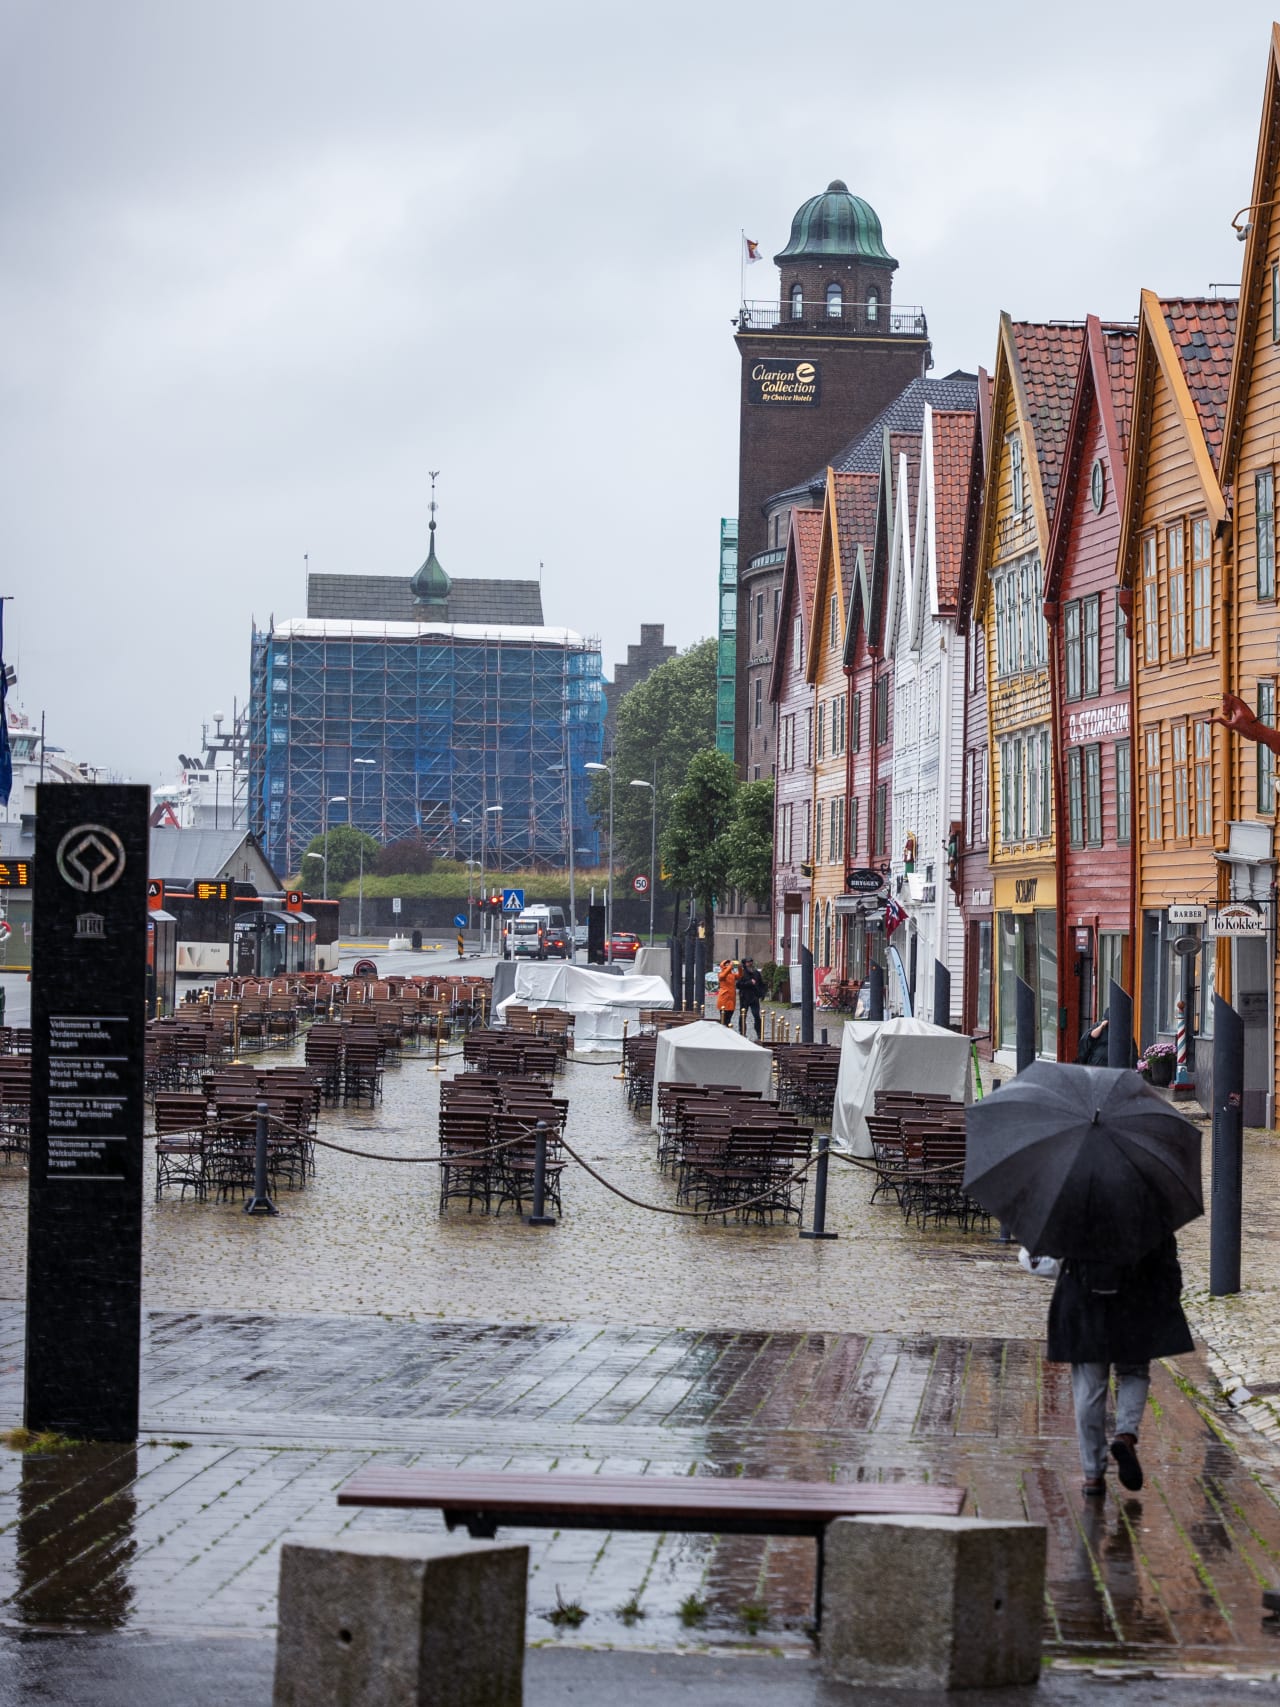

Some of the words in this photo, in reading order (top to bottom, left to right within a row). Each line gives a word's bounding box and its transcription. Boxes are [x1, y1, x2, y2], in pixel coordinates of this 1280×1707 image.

[752, 364, 795, 380] Clarion
[761, 381, 816, 393] Collection
[762, 393, 770, 402] By
[793, 394, 812, 402] Hotels
[636, 879, 647, 889] 50
[149, 884, 158, 895] A
[1174, 910, 1202, 918] BARBER
[1225, 917, 1262, 930] Kokker
[50, 1040, 79, 1048] Bryggen
[73, 1071, 102, 1079] Heritage
[49, 1080, 78, 1088] Bryggen
[49, 1119, 78, 1127] Mondial
[48, 1159, 77, 1167] Bryggen
